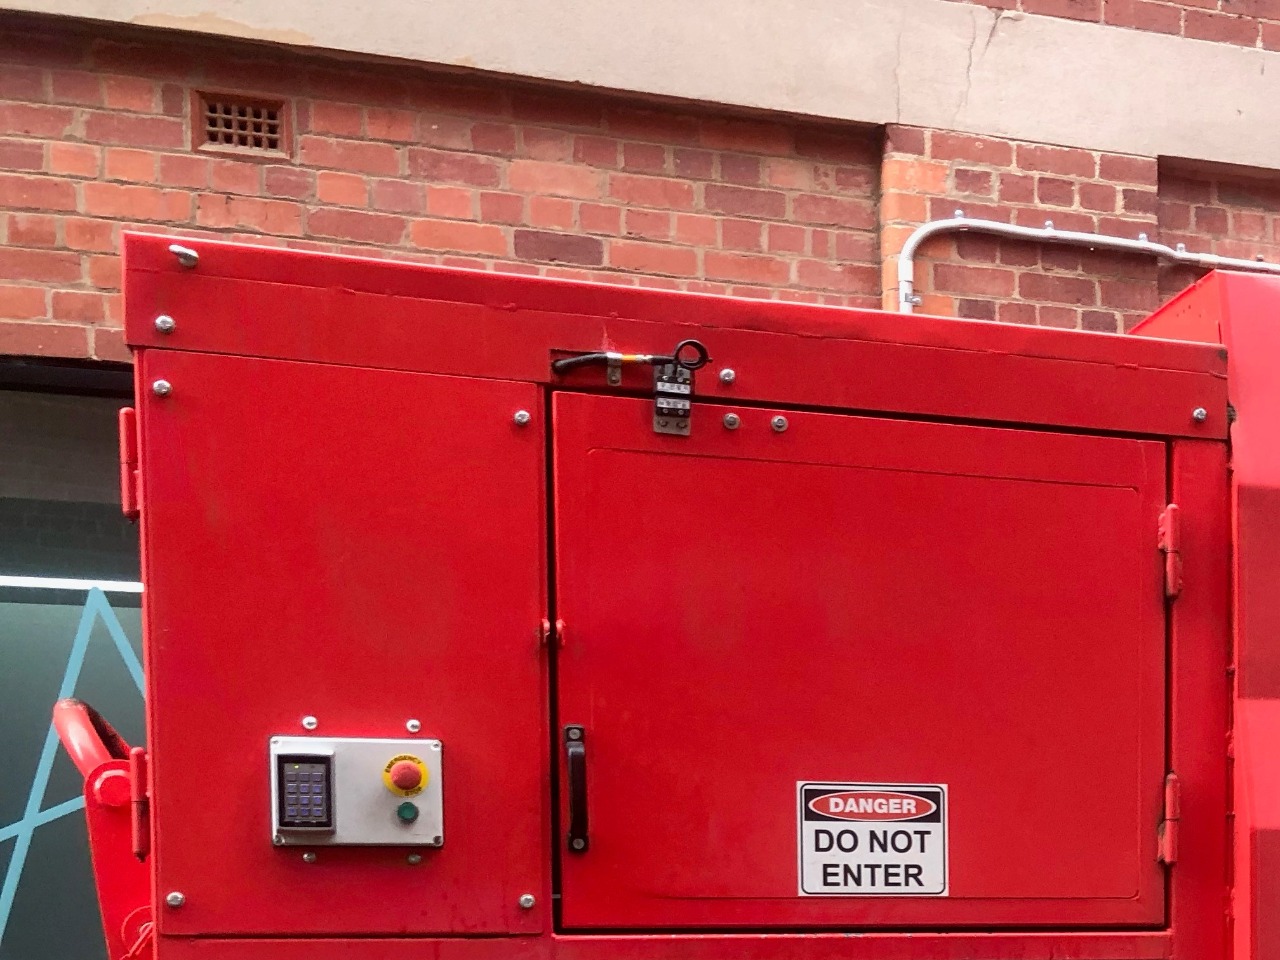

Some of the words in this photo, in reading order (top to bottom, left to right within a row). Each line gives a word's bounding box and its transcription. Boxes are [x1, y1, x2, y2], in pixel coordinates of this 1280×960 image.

[828, 797, 917, 814] DANGER
[814, 829, 859, 853] DO
[869, 830, 932, 853] NOT
[822, 863, 925, 887] ENTER
